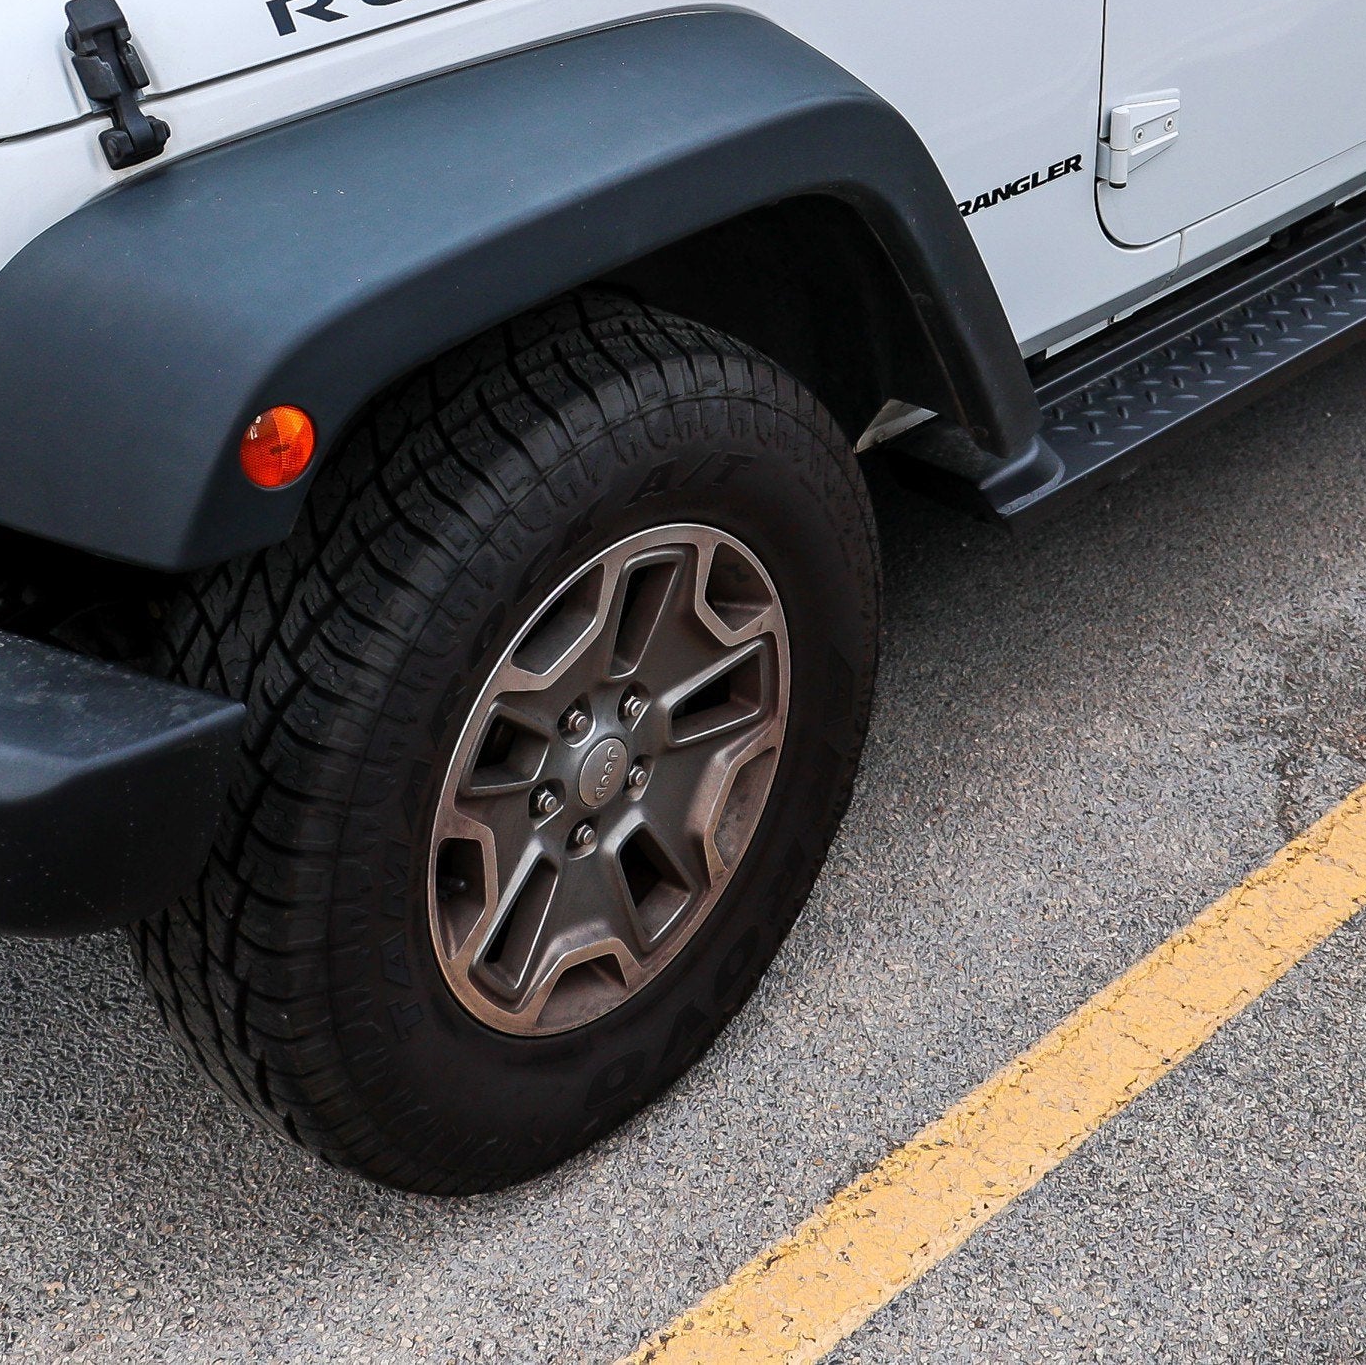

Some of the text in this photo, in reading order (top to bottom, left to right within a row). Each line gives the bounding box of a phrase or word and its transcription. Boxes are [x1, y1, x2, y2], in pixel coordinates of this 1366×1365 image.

[957, 153, 1084, 217] RANGLER
[625, 447, 757, 511] A/T
[595, 746, 619, 799] Jeep
